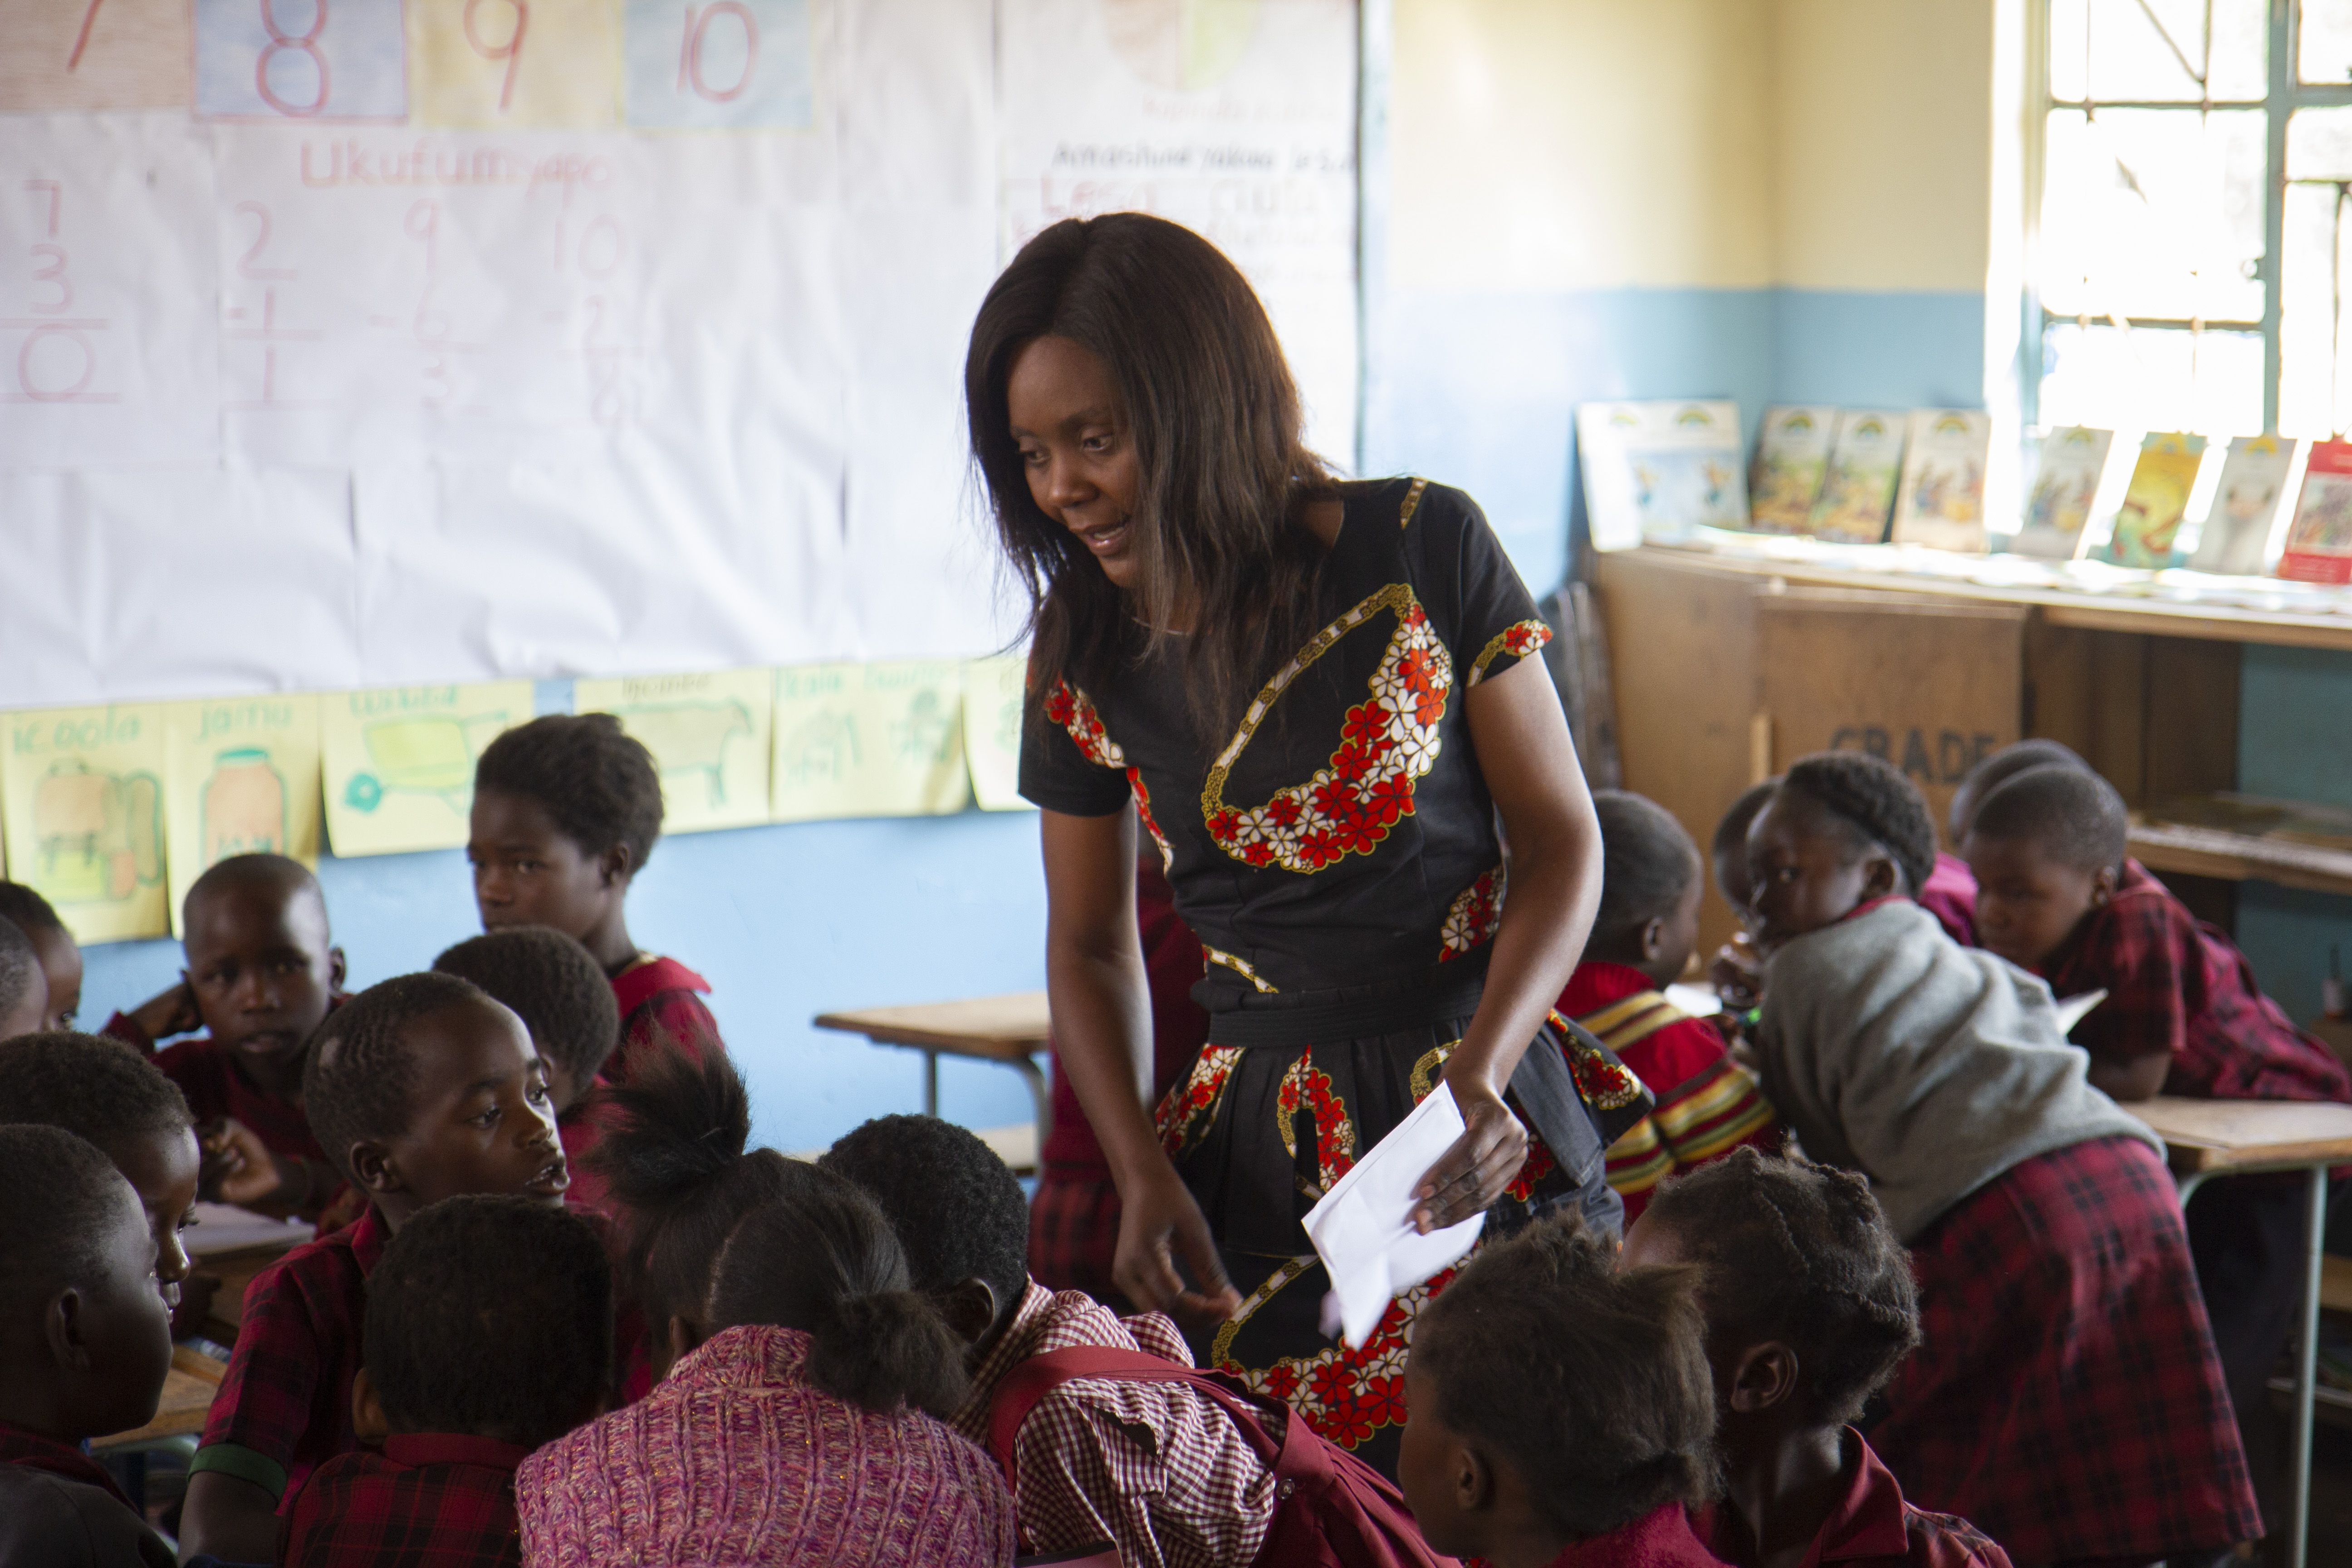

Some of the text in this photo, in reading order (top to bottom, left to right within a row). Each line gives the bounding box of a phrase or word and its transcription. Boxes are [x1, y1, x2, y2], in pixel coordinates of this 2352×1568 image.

[463, 0, 531, 113] 9
[676, 1, 760, 103] 10
[234, 200, 299, 280] 2
[403, 198, 440, 274] 9
[30, 242, 75, 315] 3
